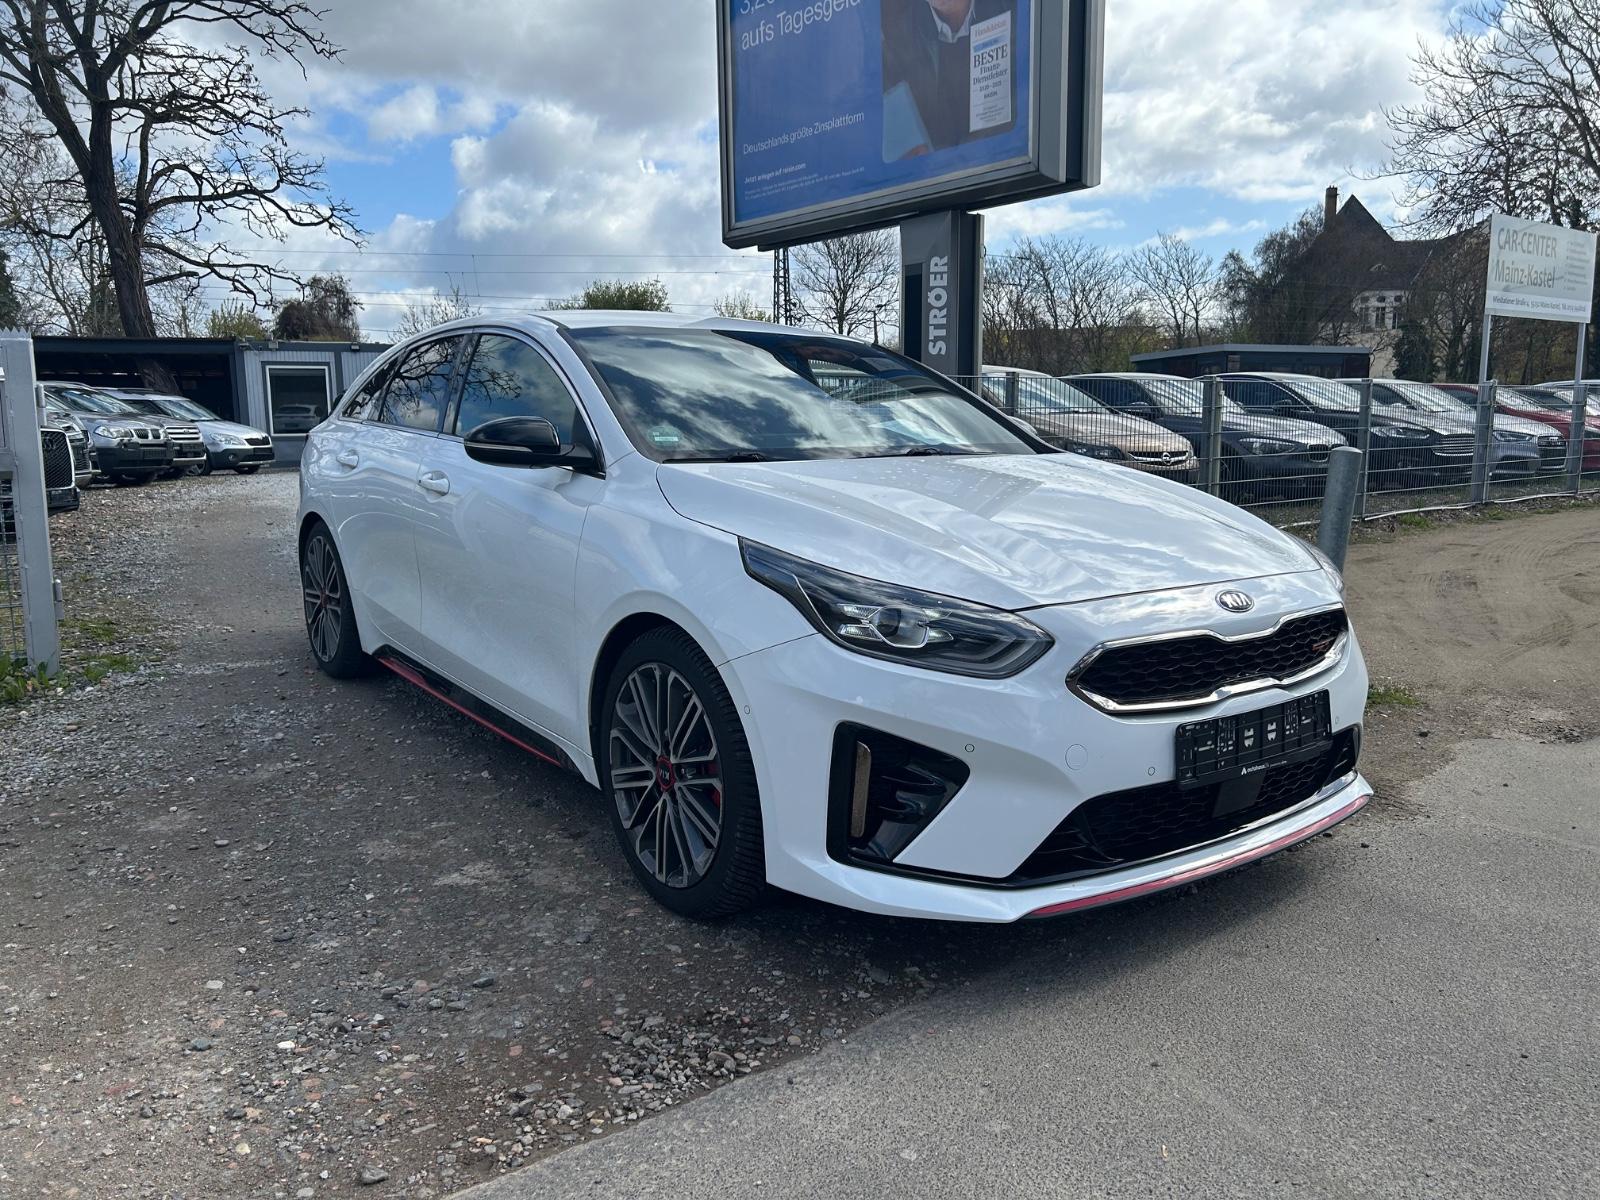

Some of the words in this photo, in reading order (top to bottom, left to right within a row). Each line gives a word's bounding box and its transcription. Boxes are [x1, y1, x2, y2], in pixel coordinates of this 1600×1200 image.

[741, 20, 775, 50] aufs
[973, 44, 1008, 68] BESTE
[743, 133, 790, 155] Deutschlands
[790, 126, 813, 144] größte
[813, 111, 865, 134] Zinsplattform
[1494, 259, 1556, 289] Mainz-Kastel
[928, 255, 948, 355] STRÖER
